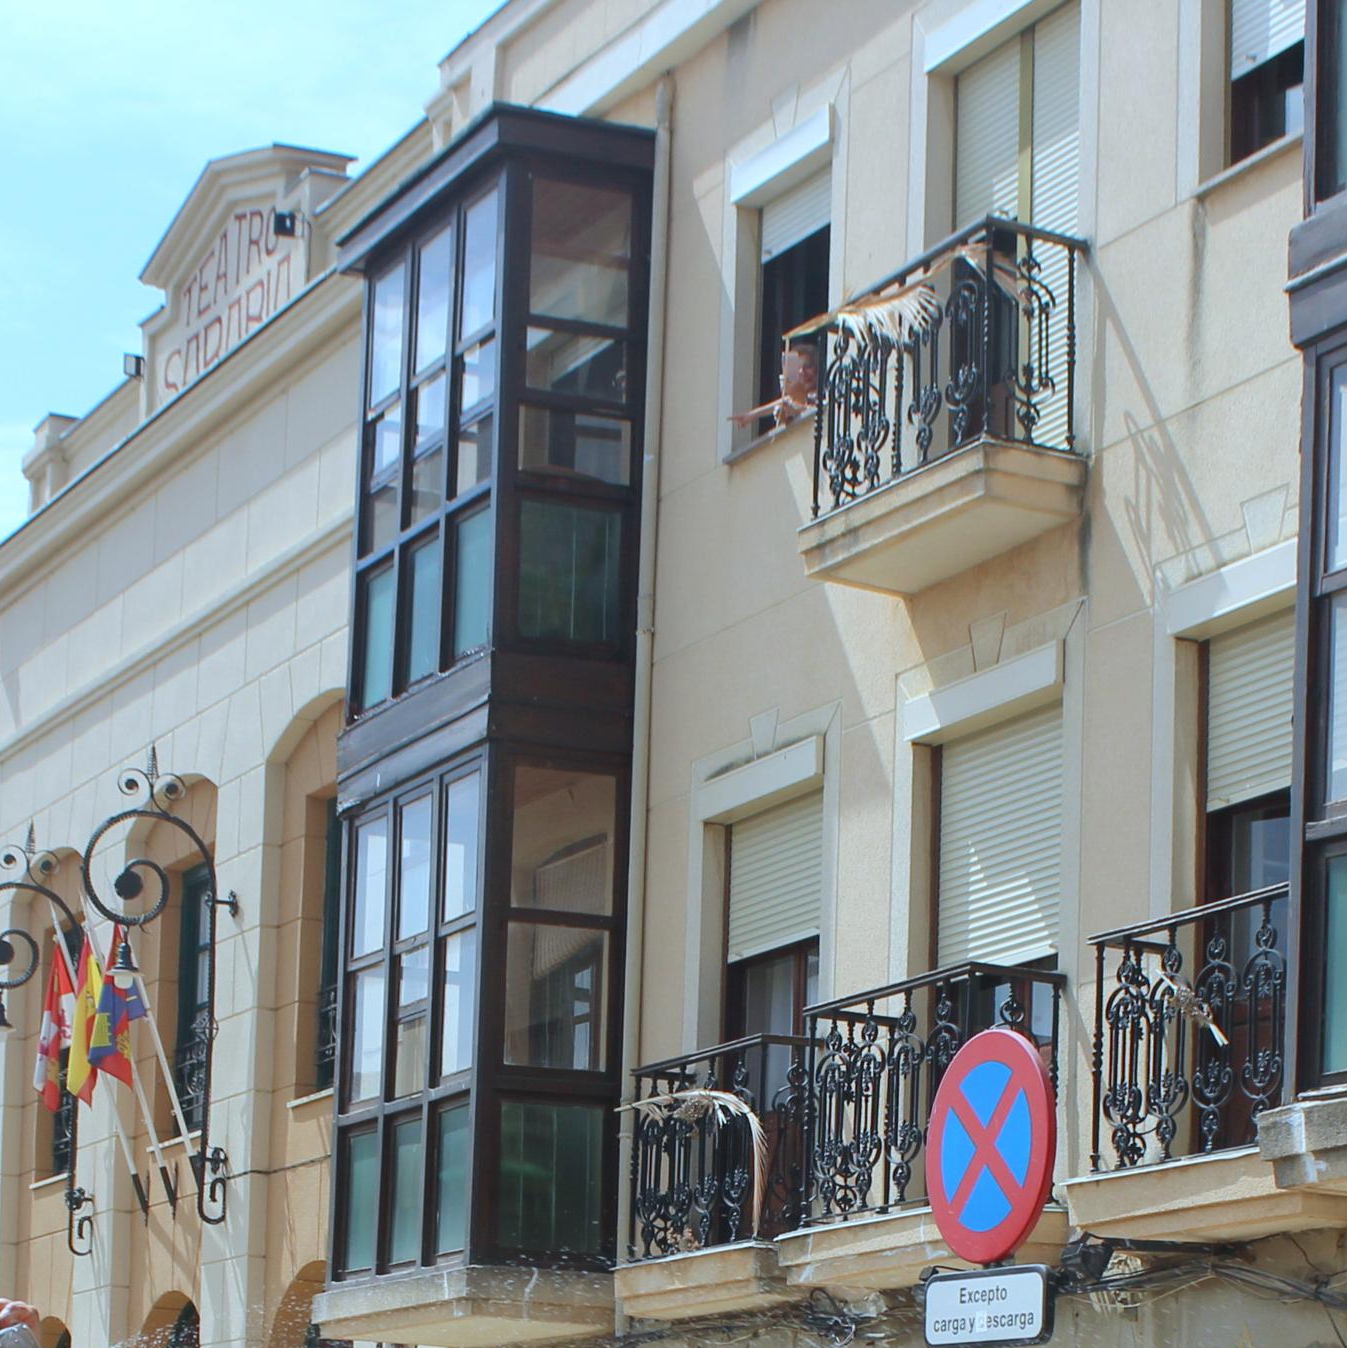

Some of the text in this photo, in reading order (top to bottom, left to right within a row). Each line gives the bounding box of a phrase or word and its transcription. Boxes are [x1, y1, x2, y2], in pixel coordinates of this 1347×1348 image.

[183, 206, 280, 328] TEATRO
[959, 1285, 1008, 1305] Excepto
[933, 1311, 1035, 1335] carga y escarga
